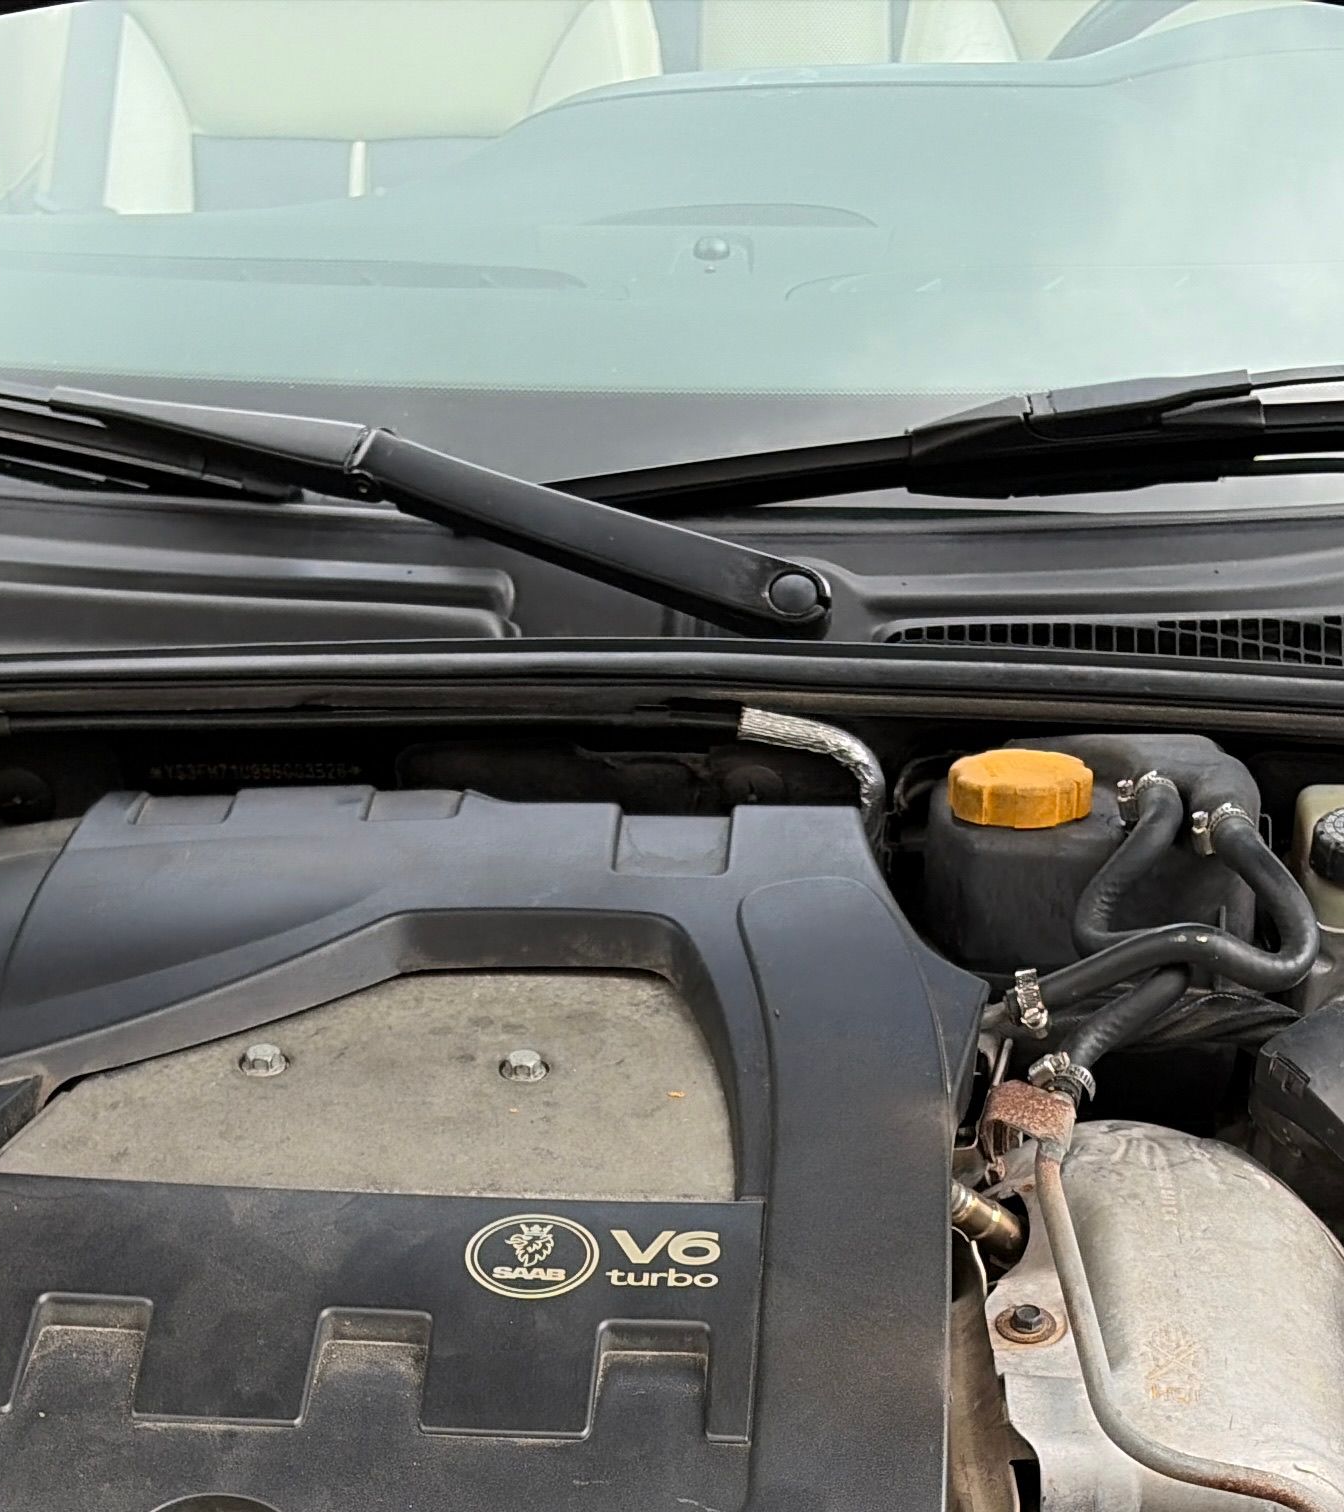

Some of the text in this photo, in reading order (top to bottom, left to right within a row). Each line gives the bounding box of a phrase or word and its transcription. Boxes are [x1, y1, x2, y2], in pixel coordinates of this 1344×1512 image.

[610, 1229, 722, 1266] V6
[492, 1266, 566, 1282] SAAB
[606, 1267, 720, 1288] turbo
